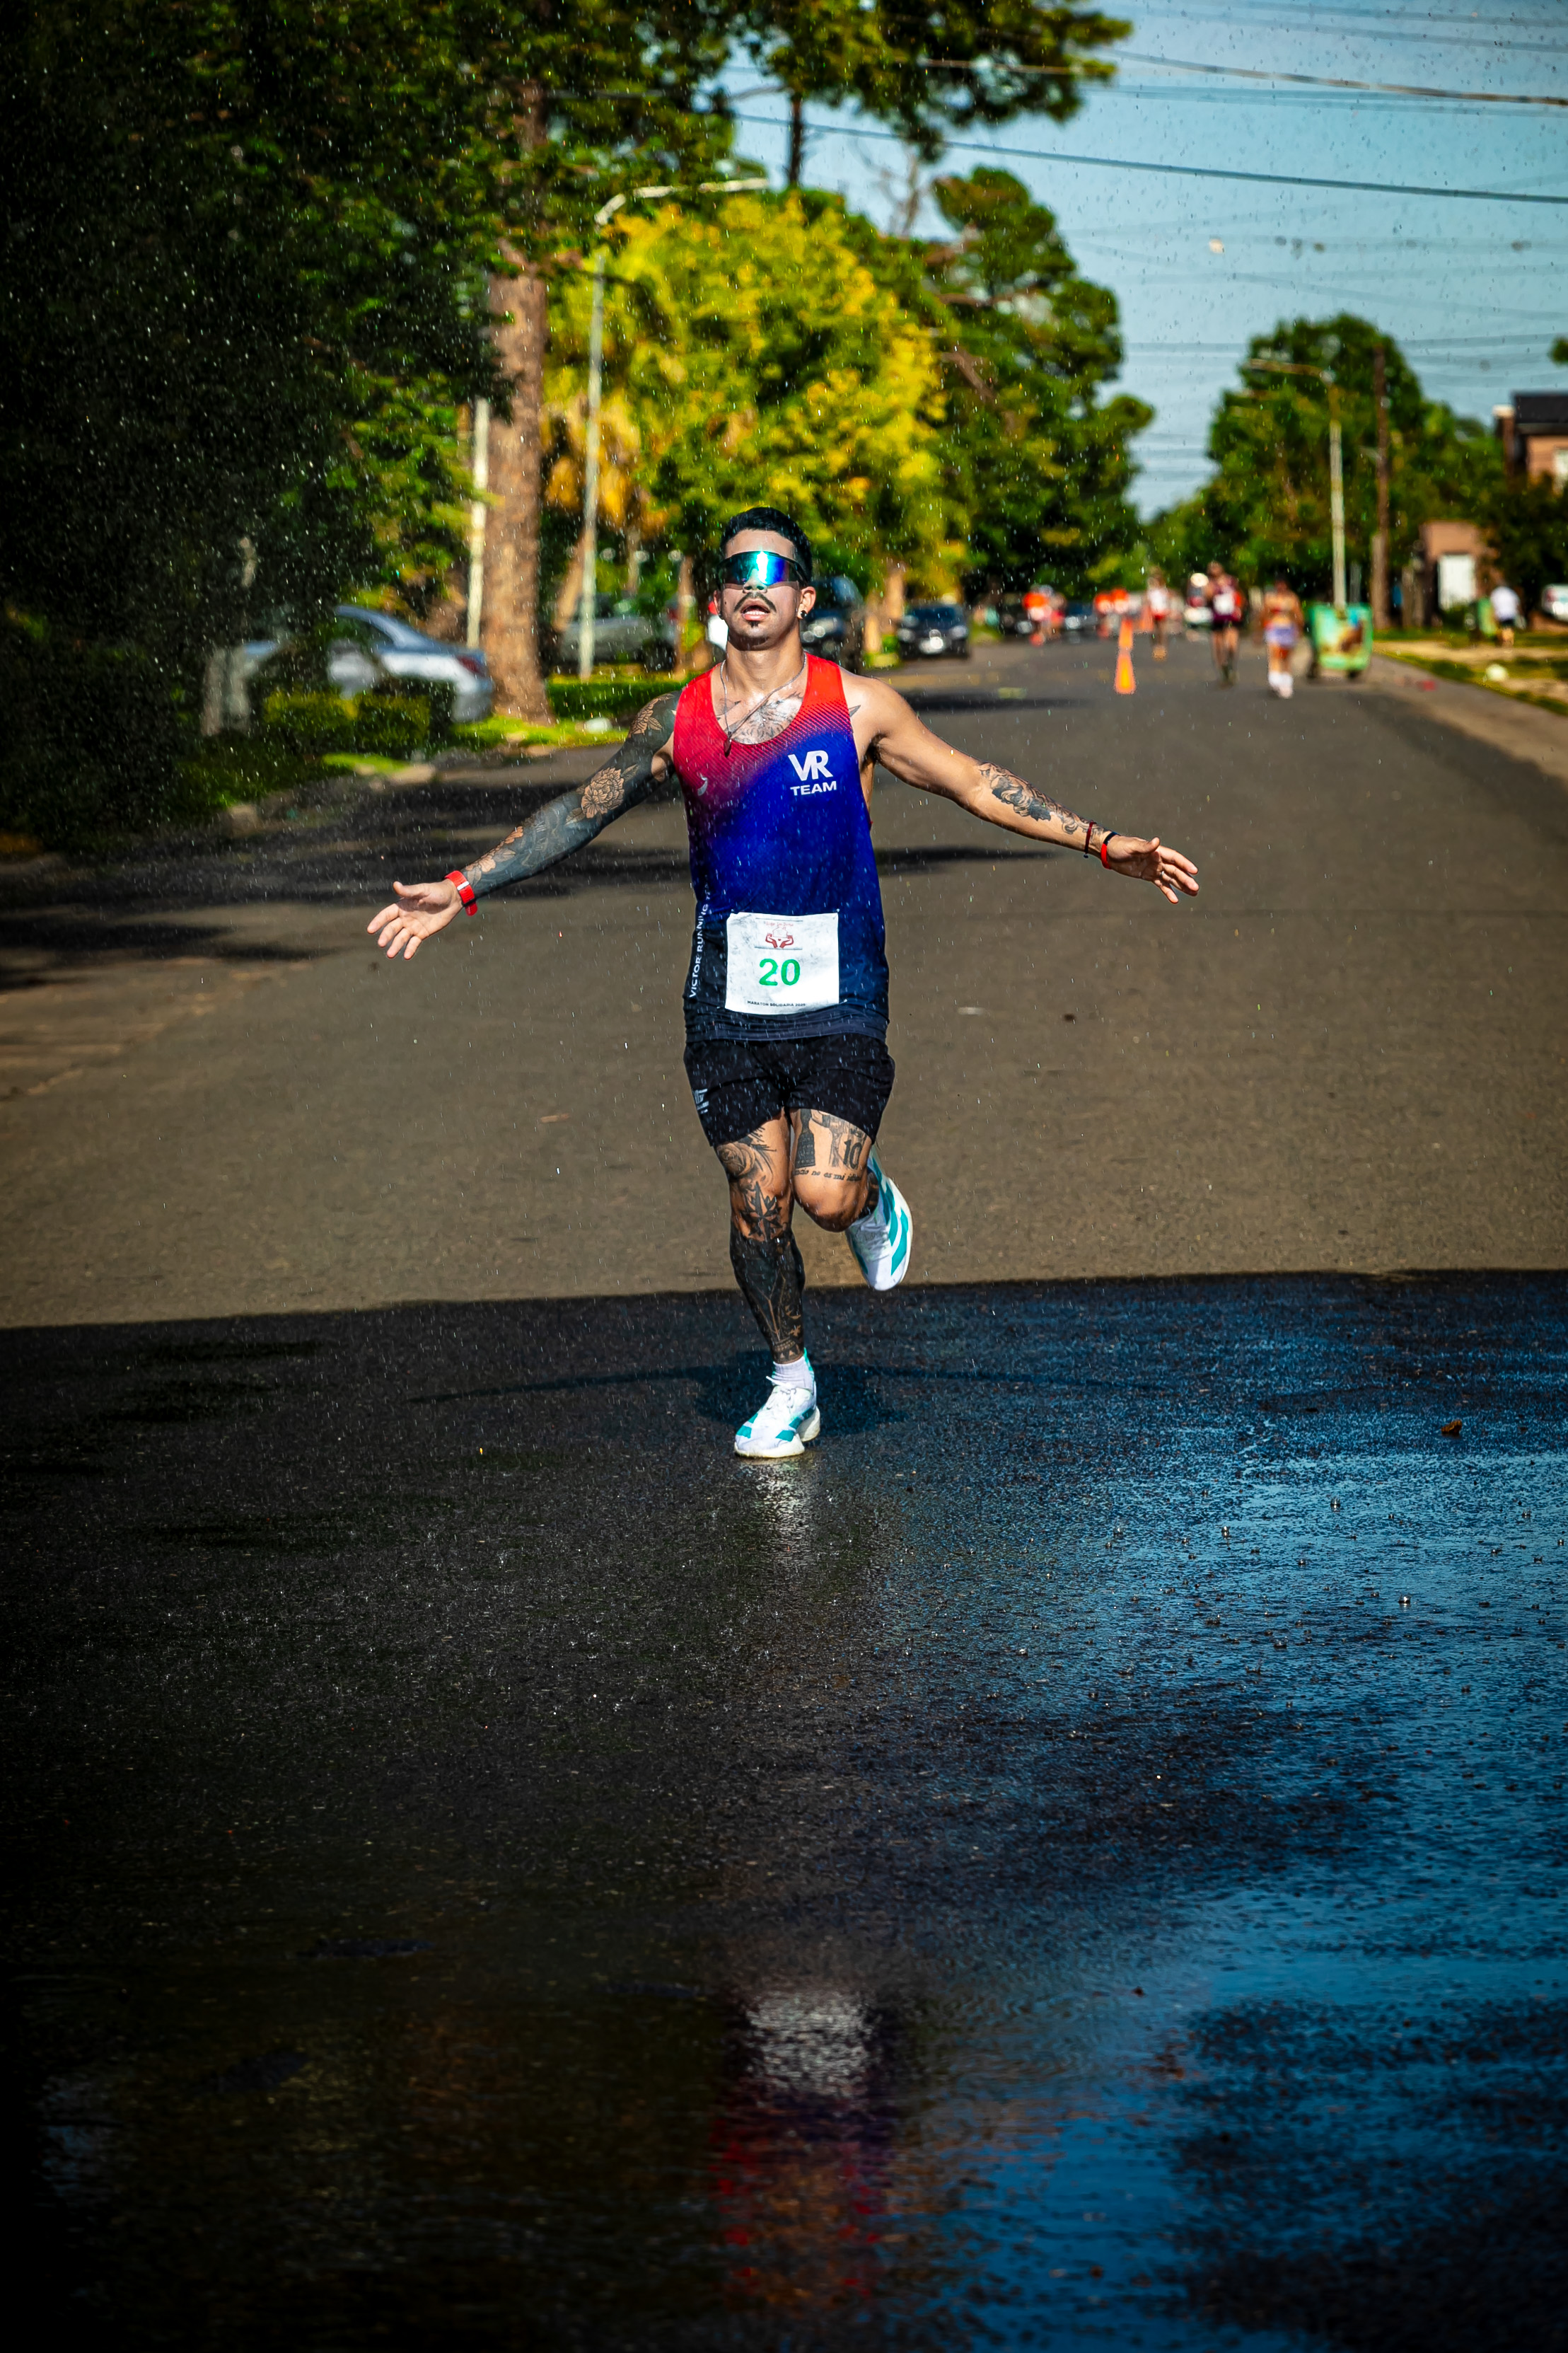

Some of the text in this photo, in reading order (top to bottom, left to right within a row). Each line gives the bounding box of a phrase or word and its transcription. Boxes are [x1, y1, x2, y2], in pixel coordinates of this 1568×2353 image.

[787, 750, 834, 781] VR
[789, 780, 837, 796] TEAM
[689, 955, 702, 998] VICTOR
[759, 958, 801, 985] 20
[844, 1139, 863, 1169] 10
